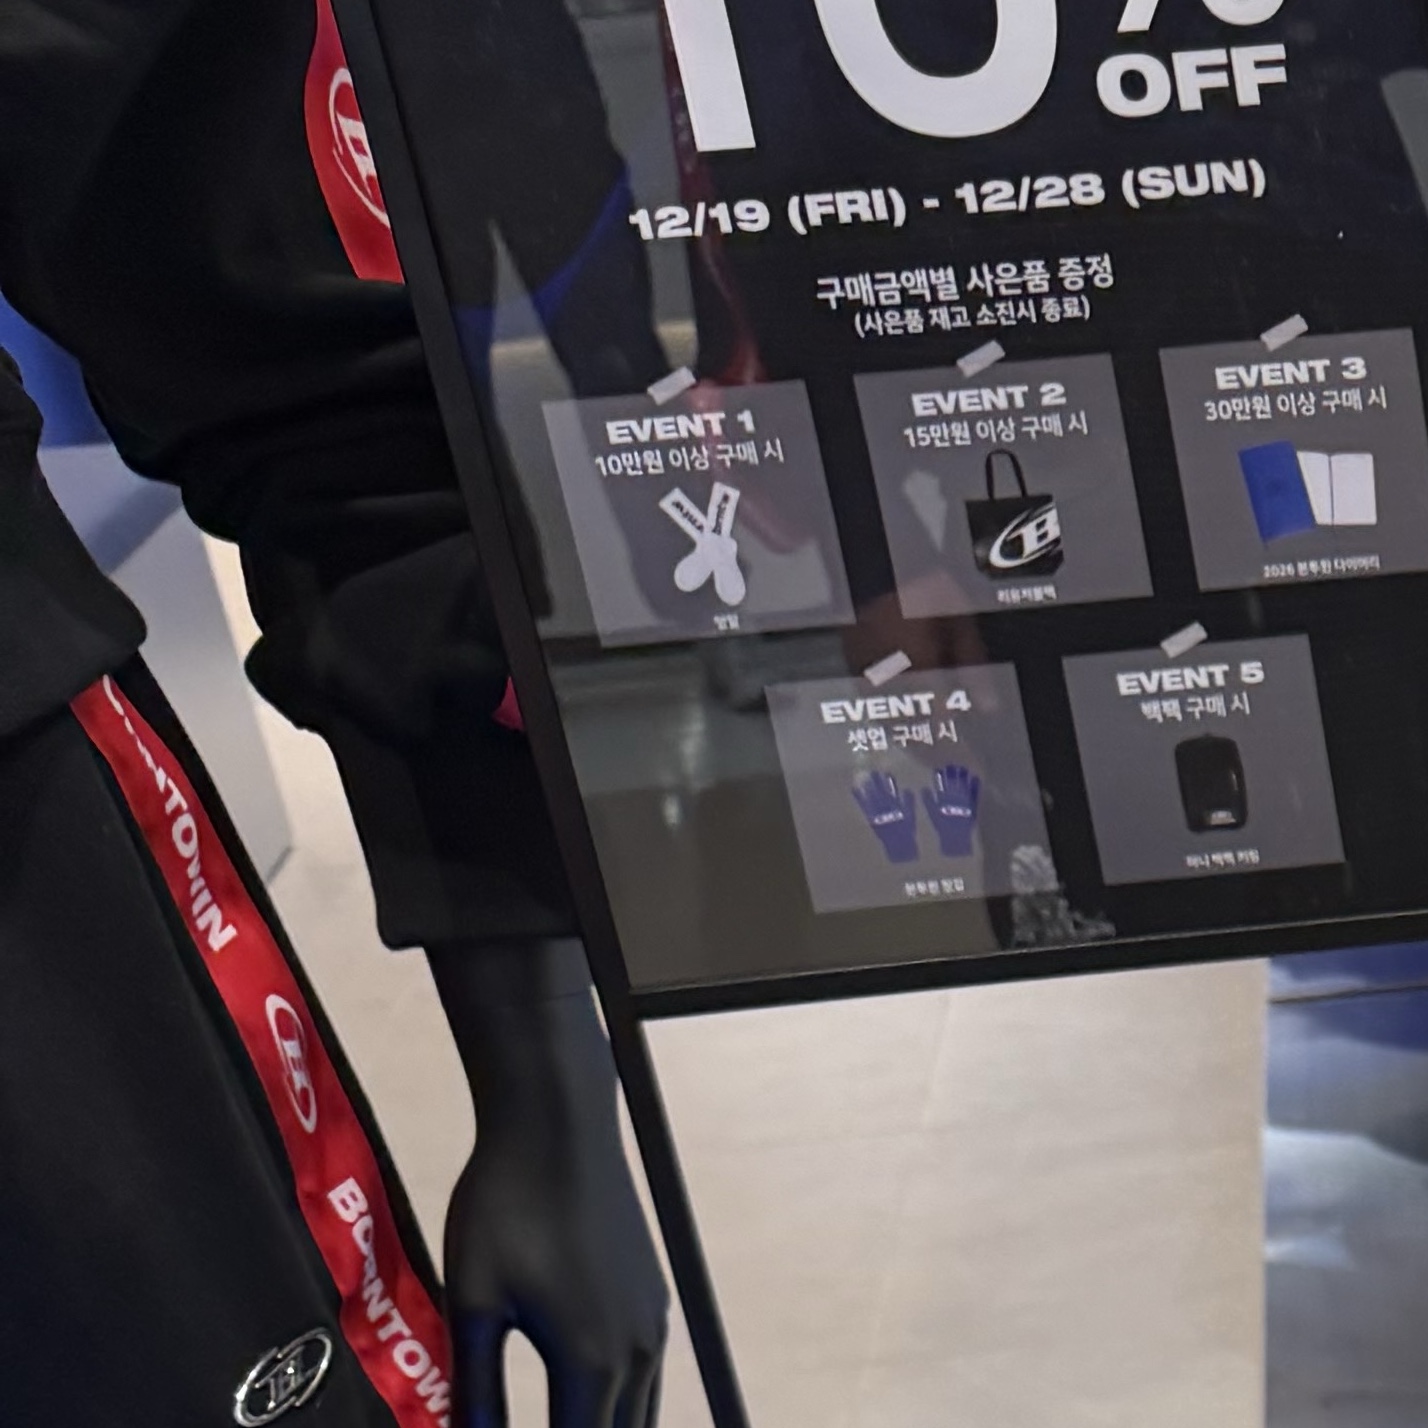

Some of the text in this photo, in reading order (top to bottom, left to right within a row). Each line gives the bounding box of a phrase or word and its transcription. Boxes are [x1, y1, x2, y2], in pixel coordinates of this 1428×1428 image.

[1097, 43, 1287, 118] OFF
[628, 199, 770, 240] 12/19
[788, 187, 906, 235] (FRI)
[955, 174, 1106, 214] 12/28
[1122, 158, 1267, 209] (SUN)
[816, 252, 1115, 310] 구매금액별 사은품 증정
[854, 294, 1091, 338] (사은품 재고 소진시 종료)
[1214, 355, 1368, 391] EVENT 3
[910, 381, 1067, 418] EVENT 2
[1203, 383, 1388, 422] 30만원 이상 구매 시
[605, 408, 756, 446] EVENT 1
[903, 409, 1089, 448] 15만원 이상 구매 시
[595, 436, 785, 477] 10만원 이상 구매 시
[1116, 660, 1266, 697] EVENT 5
[820, 689, 973, 724] EVENT 4
[1186, 692, 1228, 720] 구매
[1230, 690, 1251, 716] 시
[847, 718, 959, 752] 셋업 구매 시
